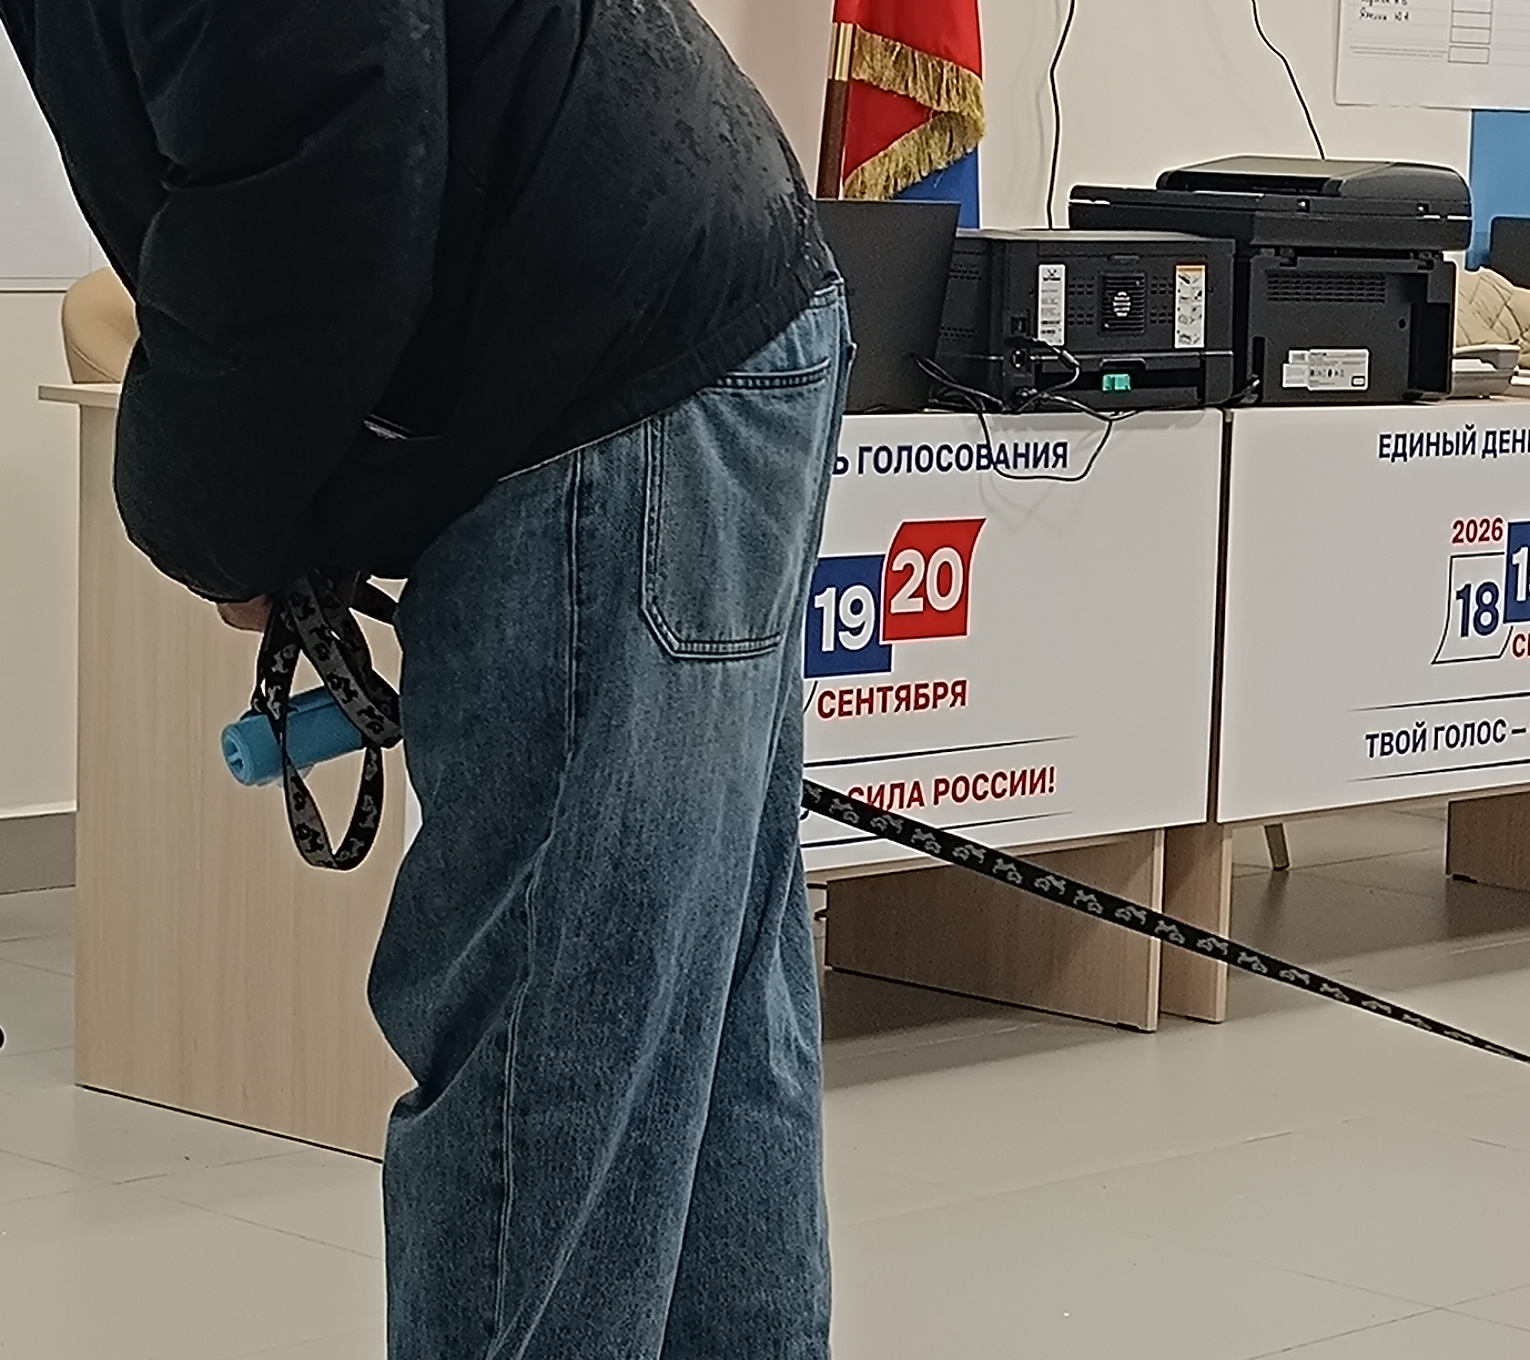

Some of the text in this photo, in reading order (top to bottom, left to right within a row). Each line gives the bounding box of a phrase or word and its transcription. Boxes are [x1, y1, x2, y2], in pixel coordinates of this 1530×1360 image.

[858, 441, 1068, 475] ГОЛОСОВАНИЯ
[1378, 423, 1477, 463] ЕДИНЫЙ
[1451, 517, 1504, 545] 2026
[814, 546, 964, 653] 19 20
[1455, 581, 1500, 638] 18
[817, 680, 968, 719] СЕНТЯБРЯ
[1365, 721, 1427, 759] ТВОЙ
[1433, 719, 1507, 751] ГОЛОС
[933, 766, 1056, 806] РОССИИ!
